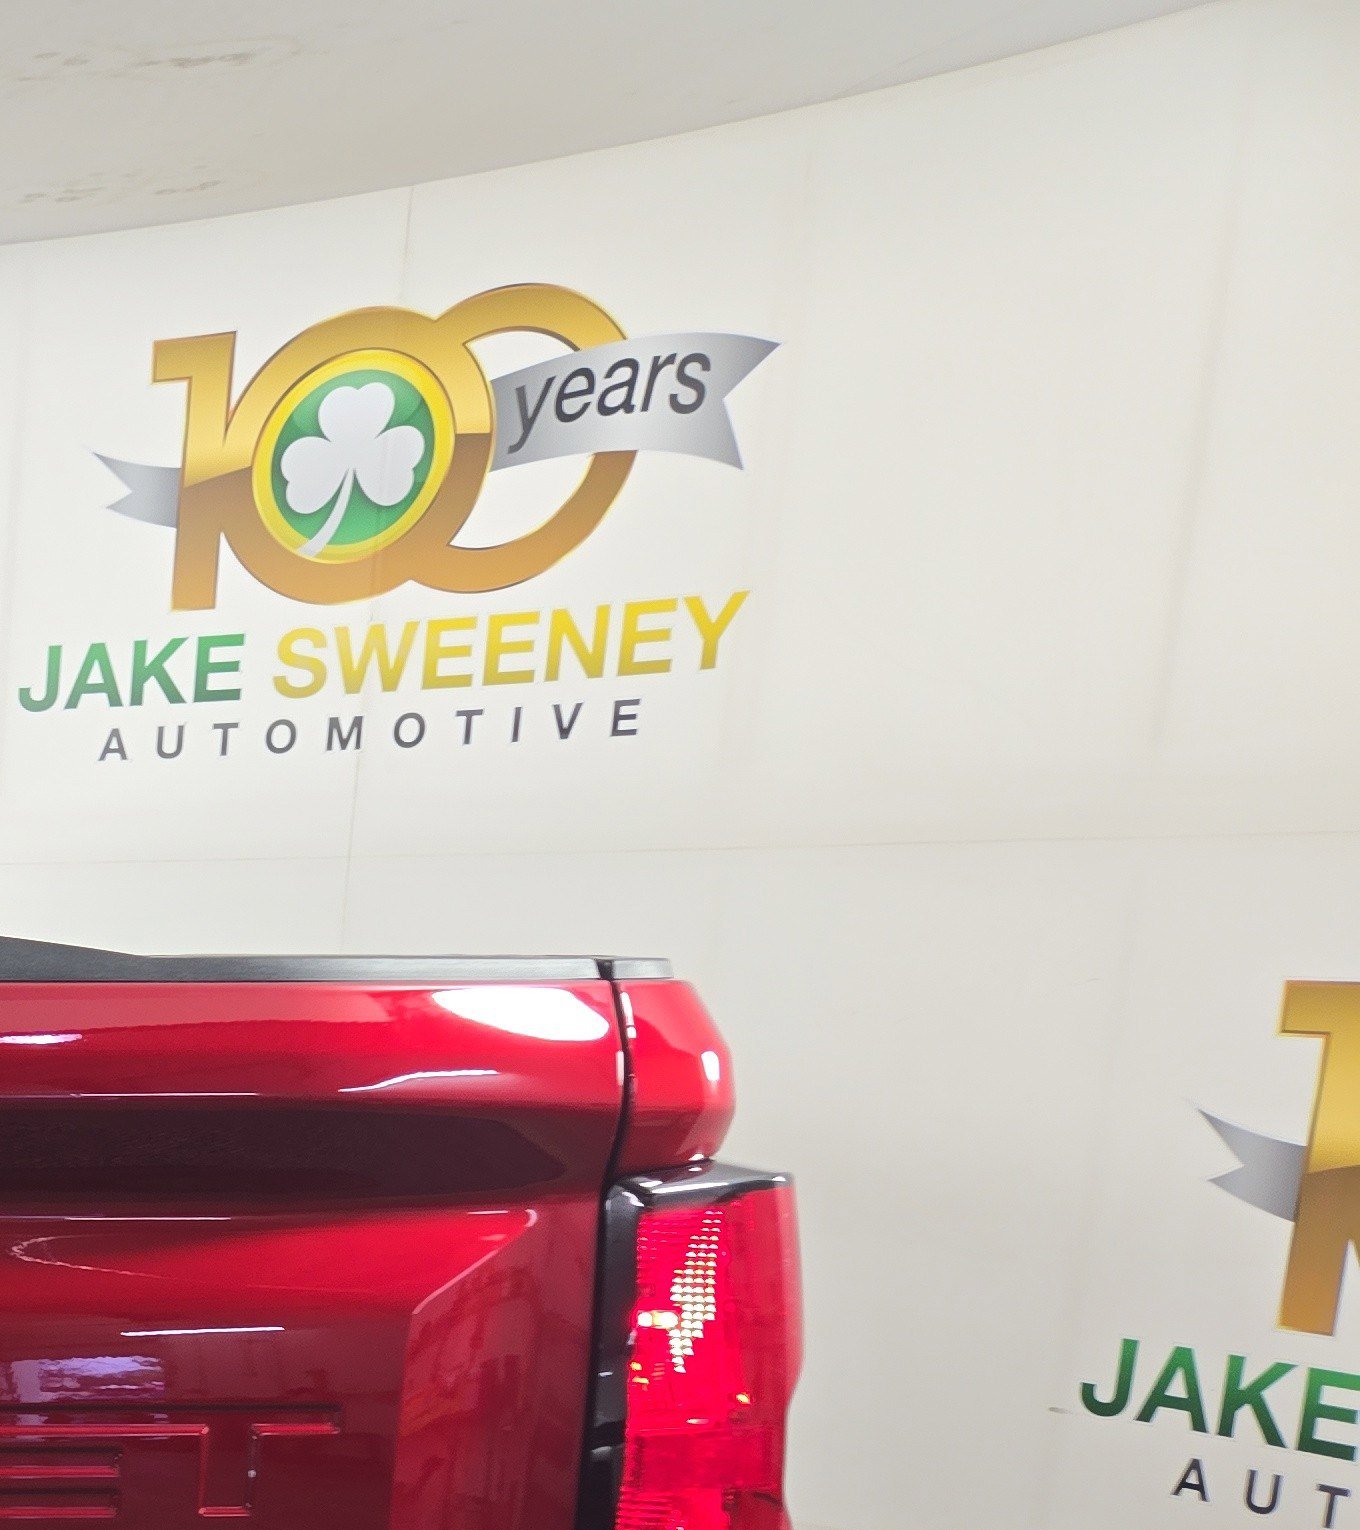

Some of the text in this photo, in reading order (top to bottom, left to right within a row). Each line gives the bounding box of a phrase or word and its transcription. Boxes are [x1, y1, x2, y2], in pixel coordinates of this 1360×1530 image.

[507, 347, 712, 455] years
[18, 590, 750, 713] JAKE SWEENEY
[96, 698, 643, 763] AUTOMOTIVE
[1080, 1337, 1360, 1462] JAKE
[1170, 1457, 1352, 1529] AUT
